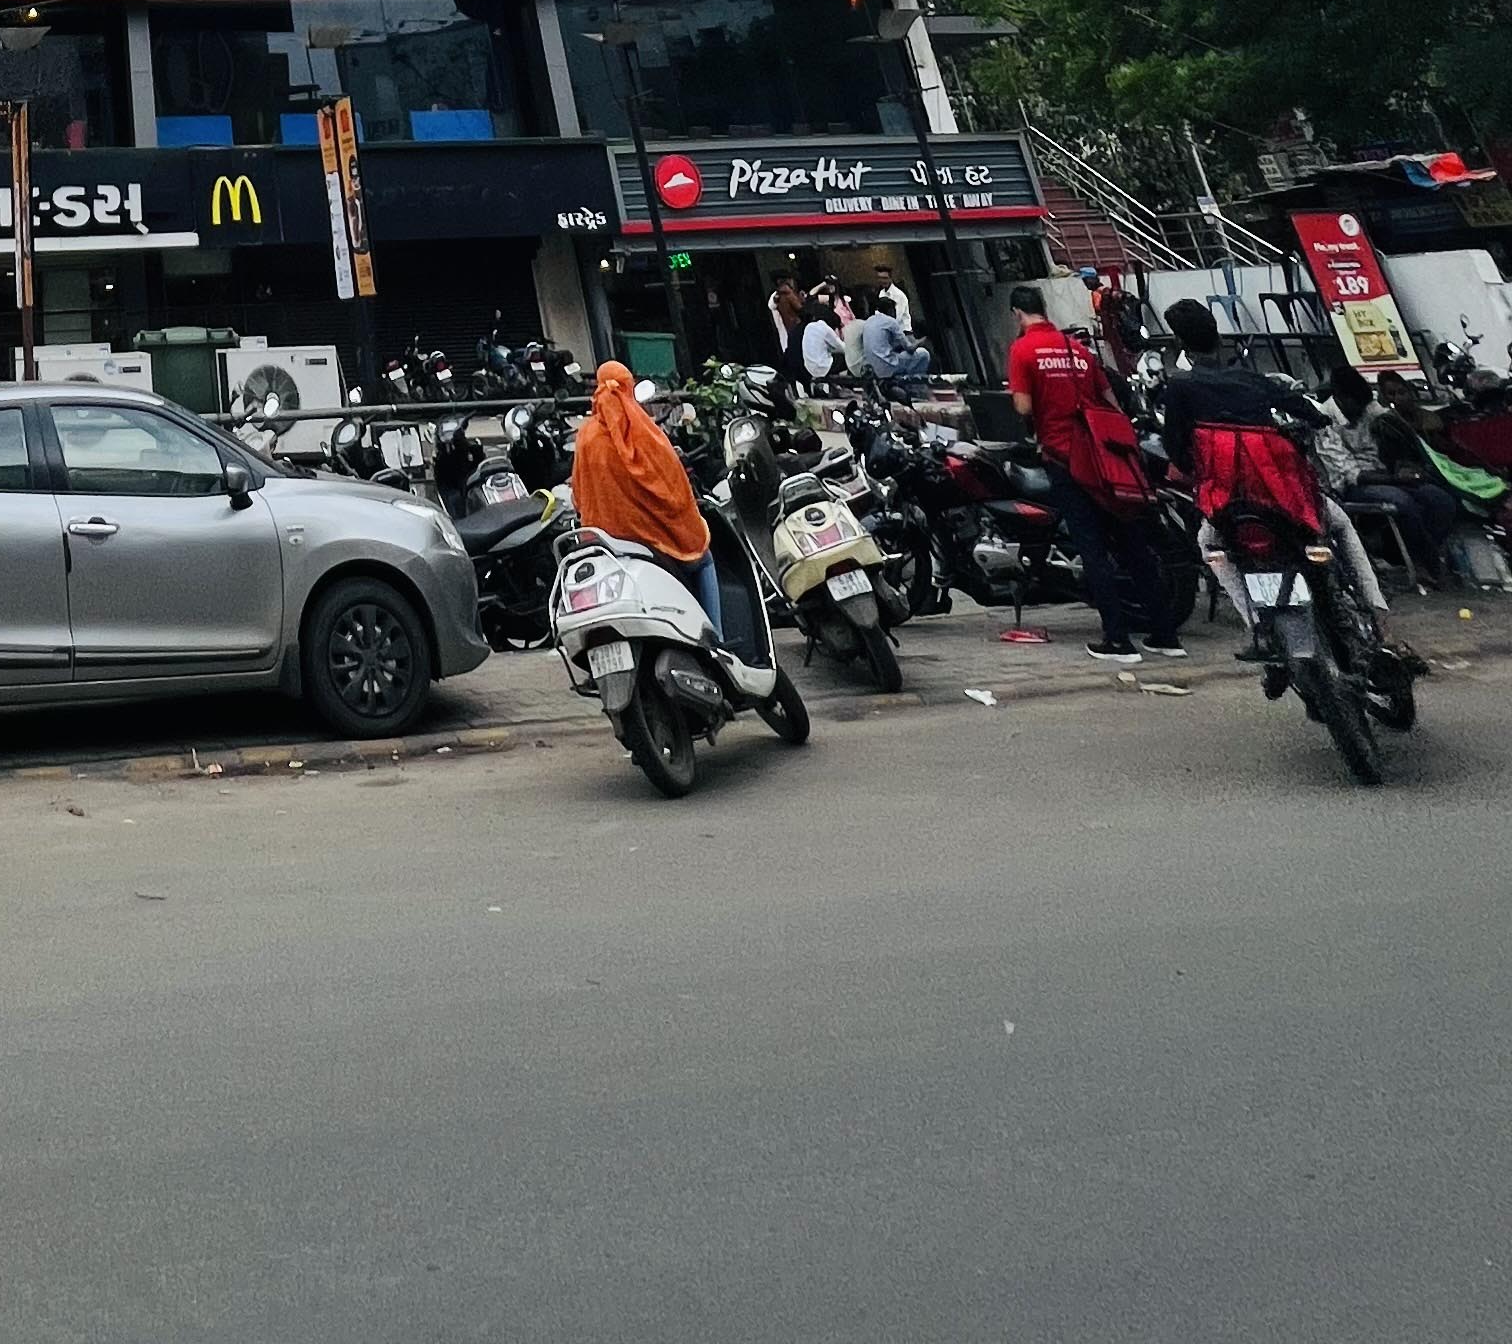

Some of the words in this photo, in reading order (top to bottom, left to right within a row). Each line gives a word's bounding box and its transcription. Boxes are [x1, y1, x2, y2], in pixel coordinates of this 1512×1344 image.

[729, 158, 810, 198] Pizza
[811, 156, 872, 192] Hut
[965, 165, 993, 186] હટ
[825, 197, 873, 213] DELIVERY
[962, 192, 993, 208] AWAY
